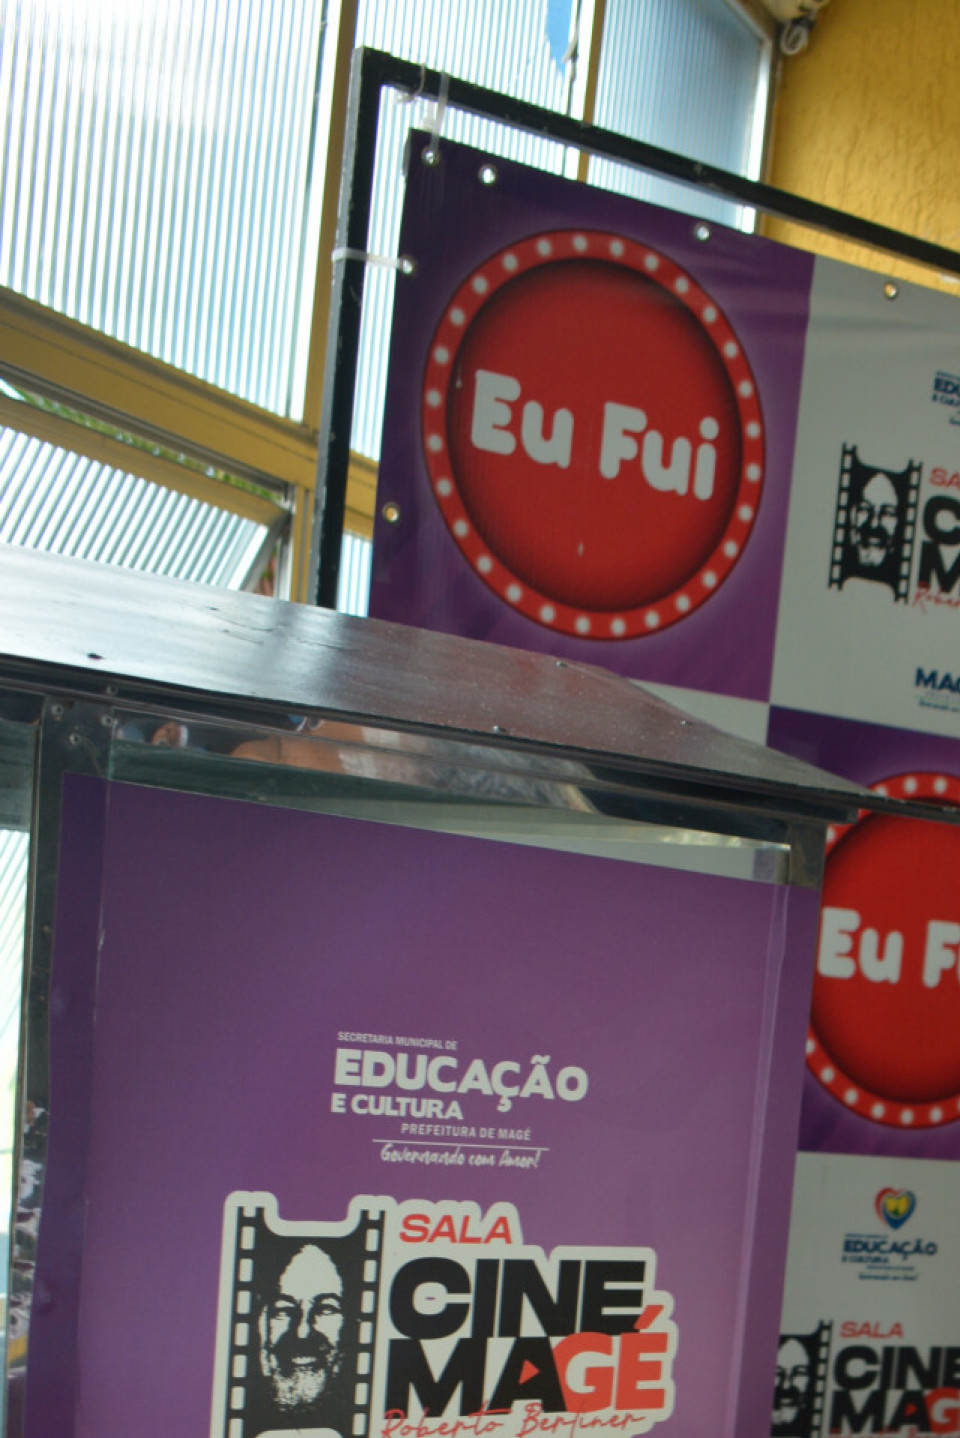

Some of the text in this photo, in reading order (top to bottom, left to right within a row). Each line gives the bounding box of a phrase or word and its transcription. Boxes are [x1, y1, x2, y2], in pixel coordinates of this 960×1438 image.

[470, 368, 719, 501] Eu Fui
[816, 906, 904, 985] Eu
[337, 1031, 458, 1051] SECRETARIA MUNICIPAL DE
[334, 1047, 589, 1113] EDUCAÇÃO
[330, 1093, 464, 1120] E CULTURA
[401, 1123, 532, 1141] PREFEITURA DE MAGÉ
[380, 1142, 466, 1166] Governando
[468, 1155, 496, 1167] com
[399, 1213, 513, 1245] SALA
[388, 1256, 646, 1340] CINE
[839, 1320, 904, 1339] SALA
[384, 1304, 668, 1421] MAGÉ
